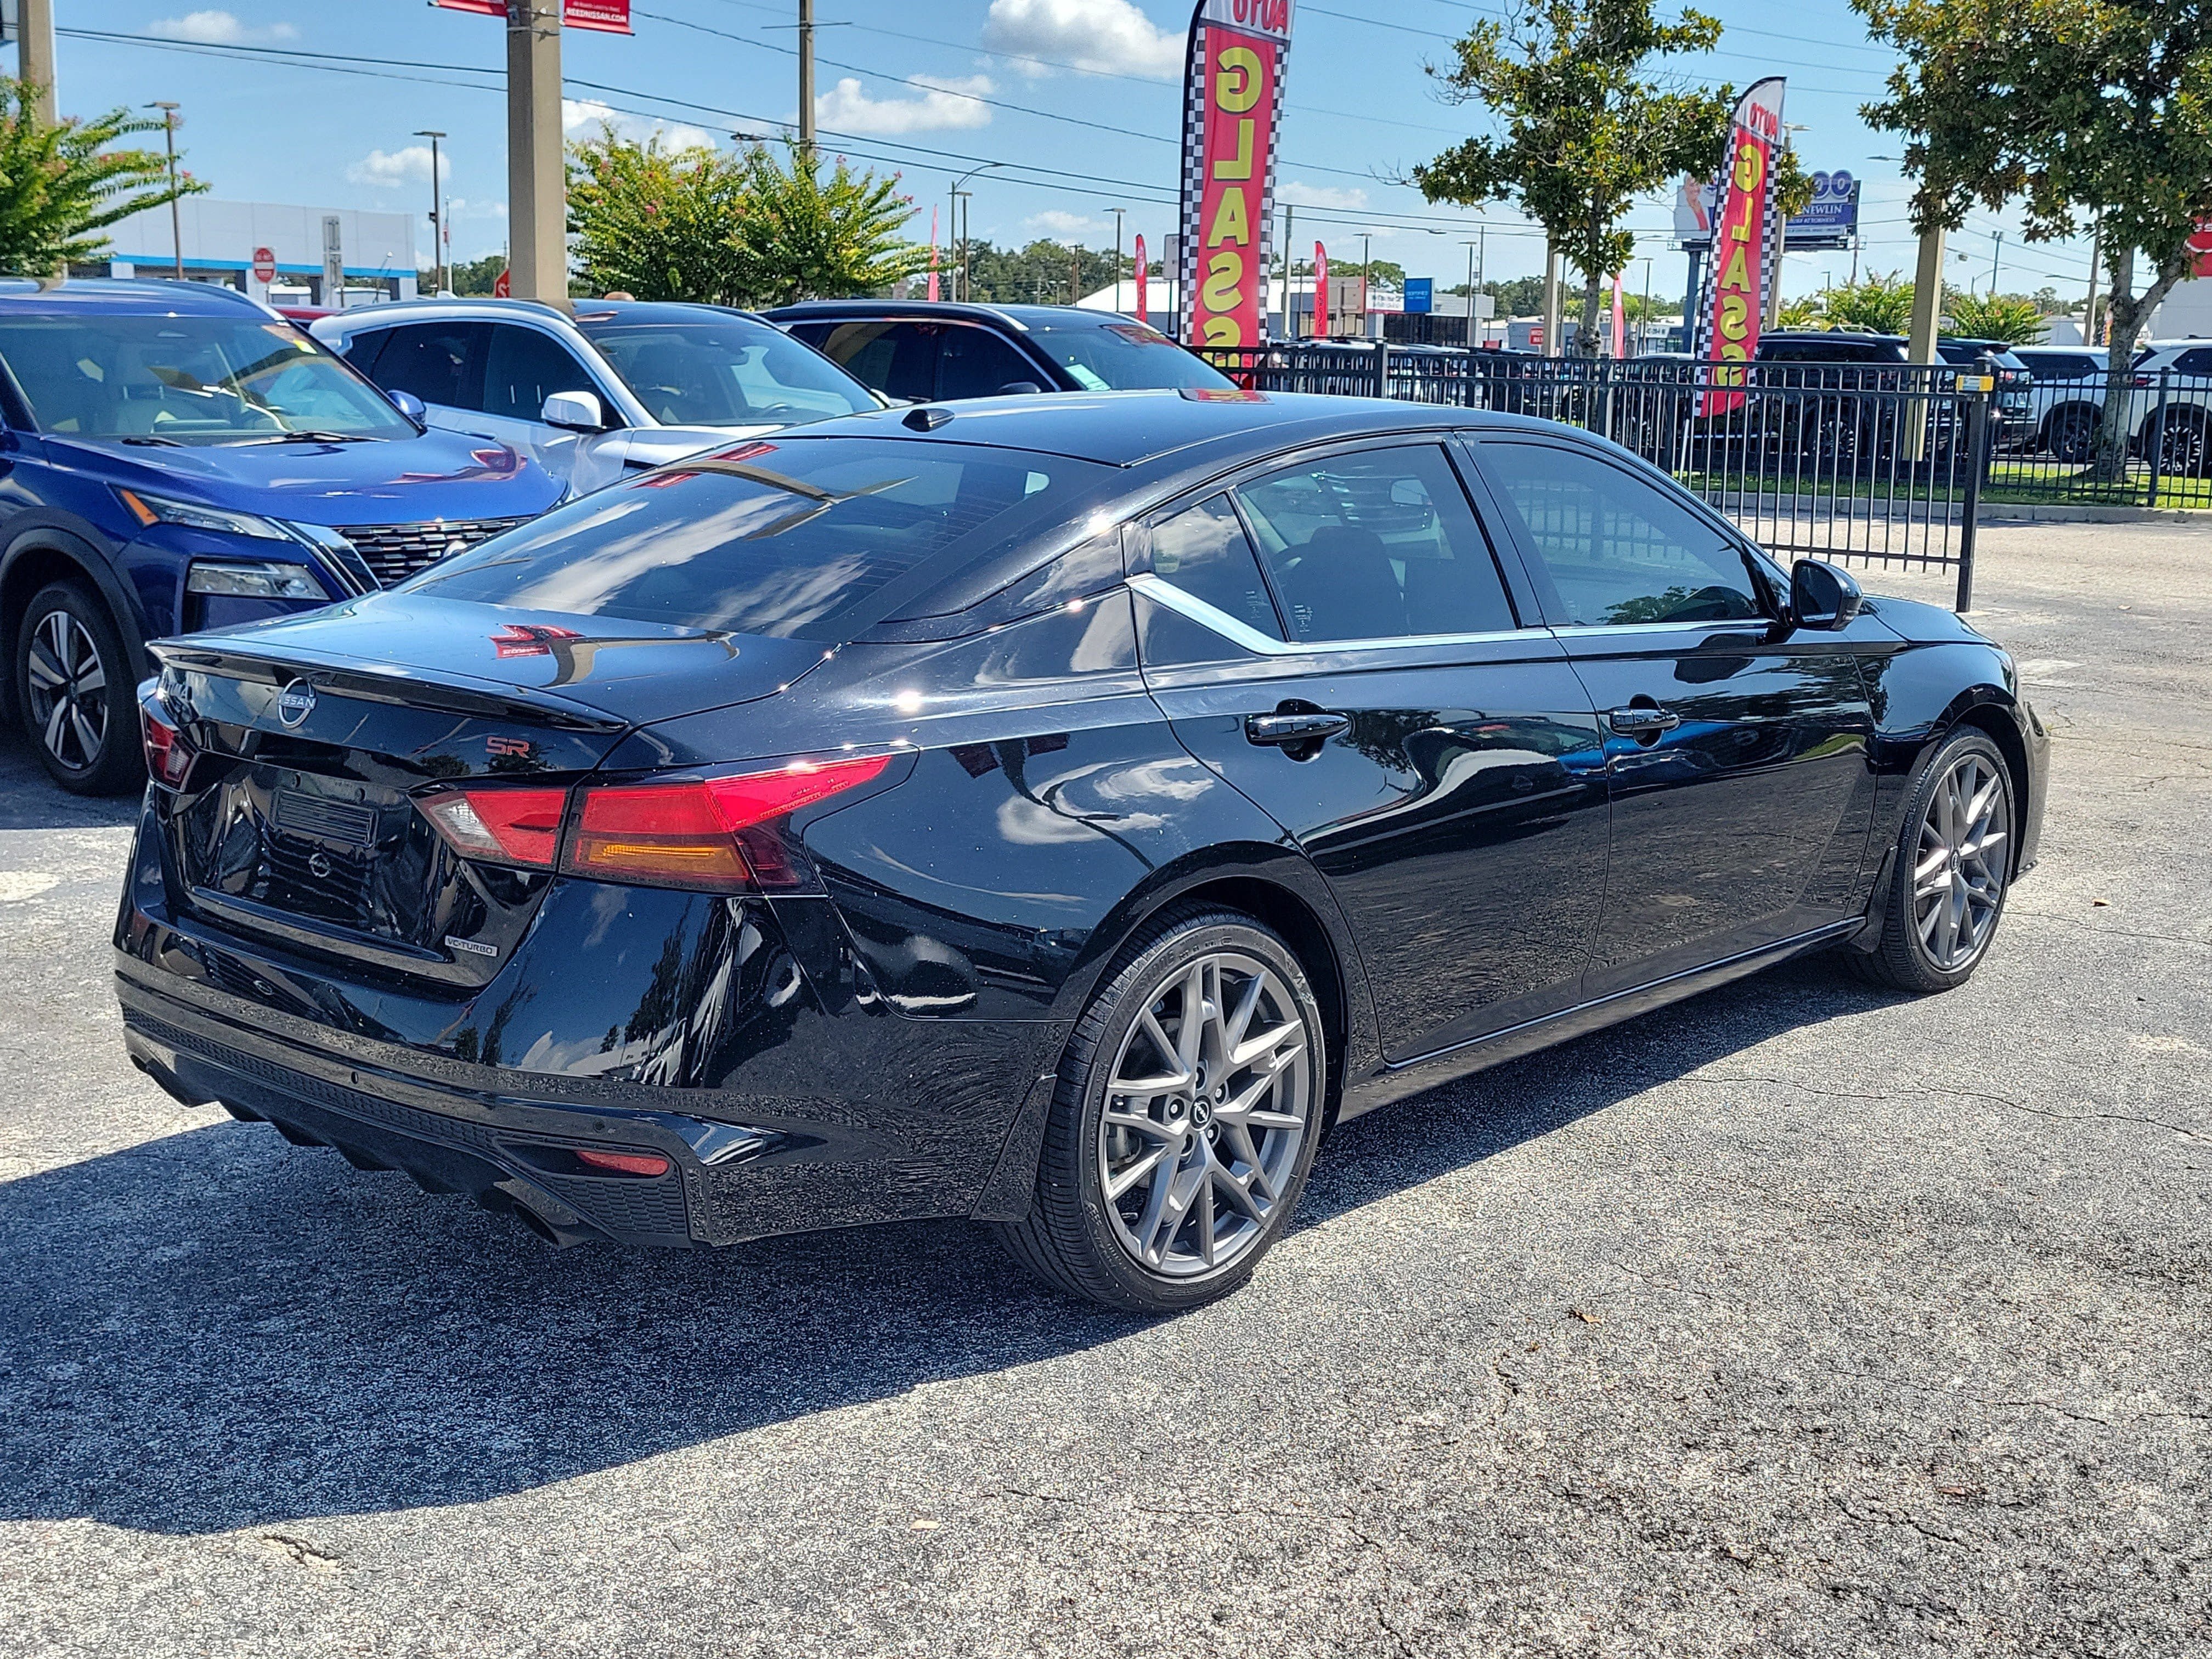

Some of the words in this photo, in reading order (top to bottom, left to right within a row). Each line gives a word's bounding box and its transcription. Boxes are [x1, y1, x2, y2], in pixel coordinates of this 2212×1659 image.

[1802, 205, 1842, 215] NEWLIN
[279, 695, 316, 709] SSAN
[486, 736, 530, 759] SR
